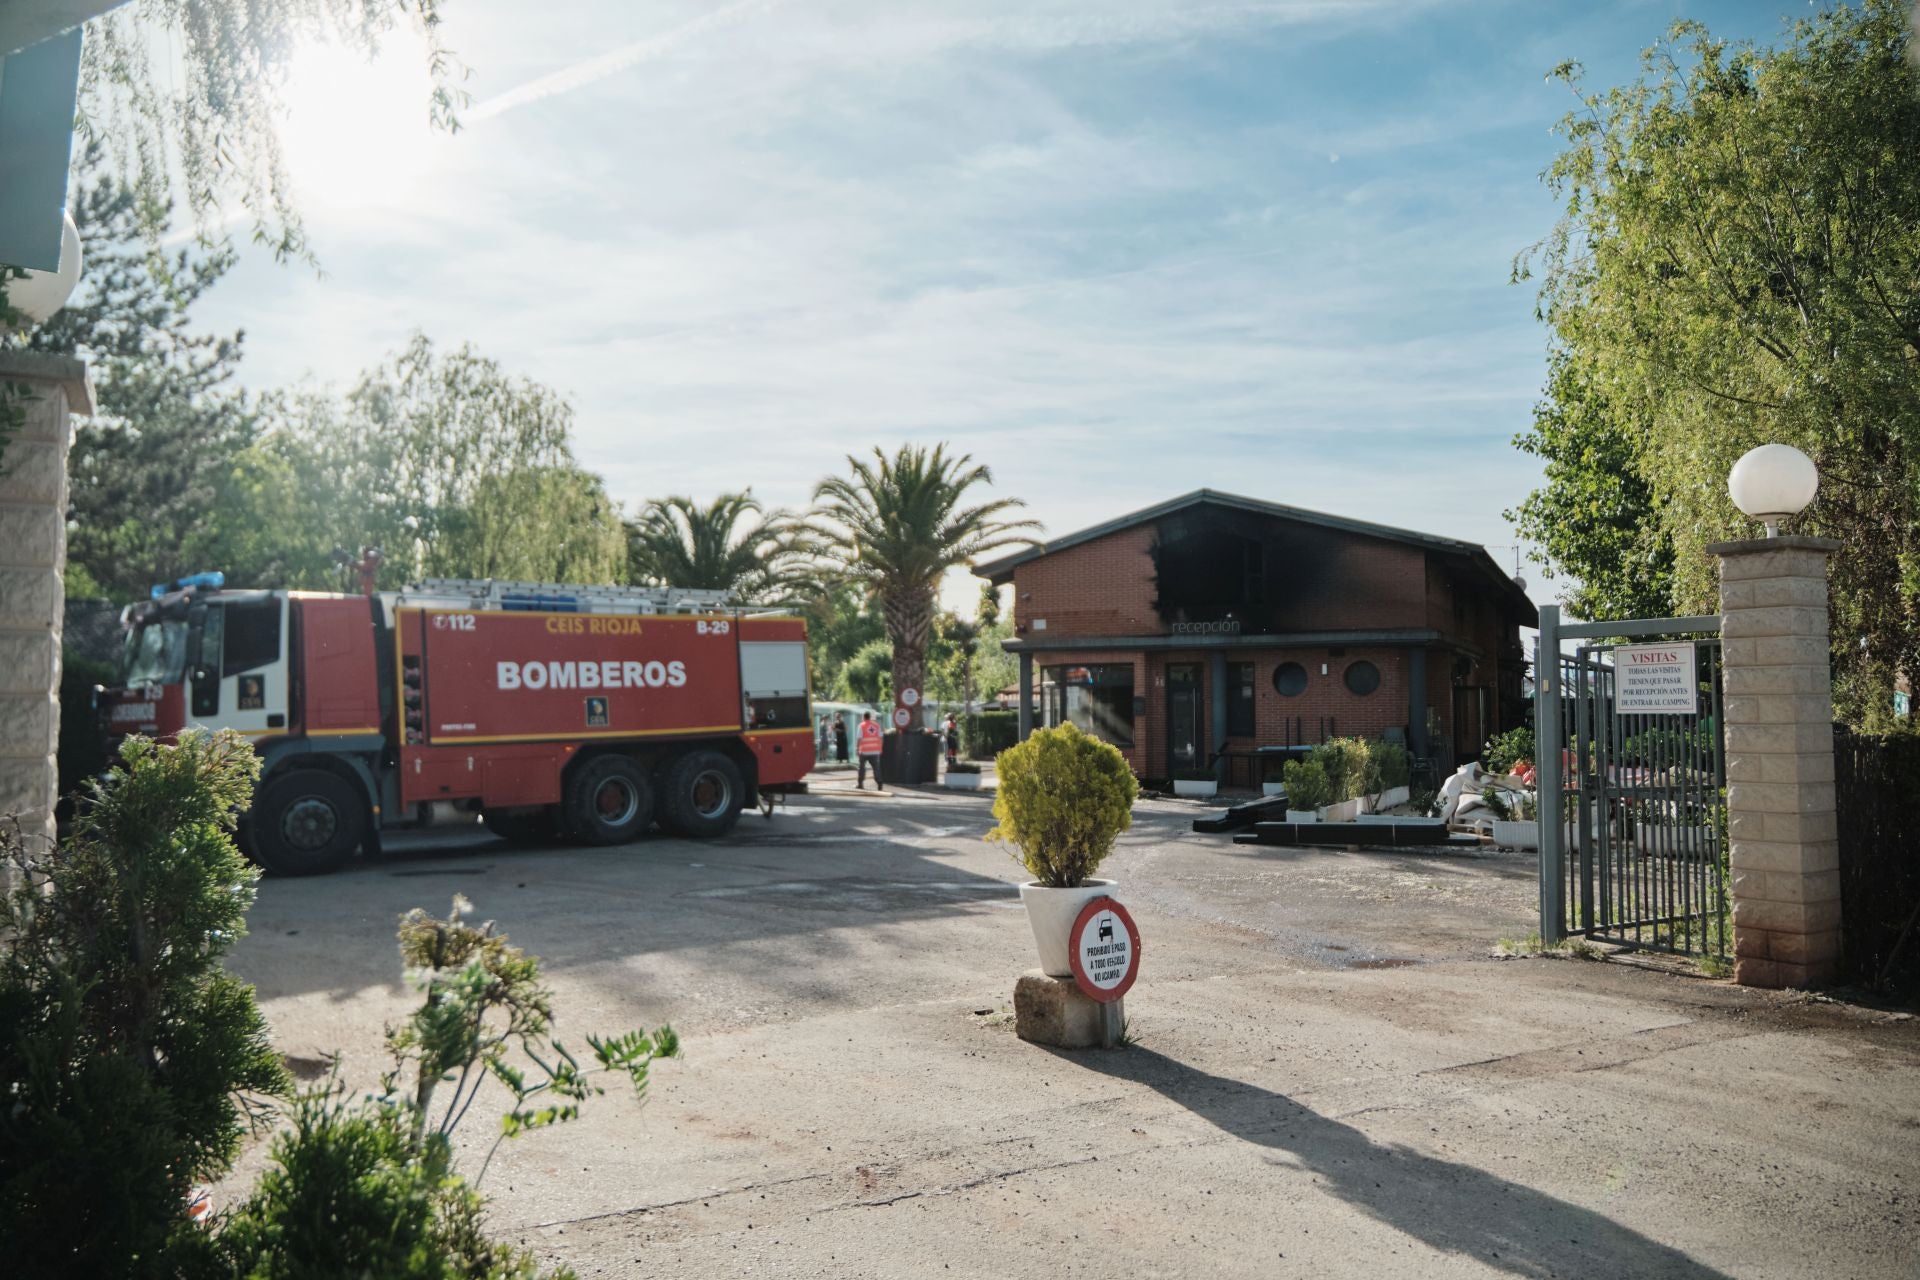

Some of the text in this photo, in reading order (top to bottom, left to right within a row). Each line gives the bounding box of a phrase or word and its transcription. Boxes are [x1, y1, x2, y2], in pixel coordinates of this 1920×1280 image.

[448, 614, 476, 631] 112
[546, 617, 642, 635] CEIS RIOJA
[697, 620, 729, 635] B-29
[1631, 652, 1678, 664] VISITAS
[496, 660, 687, 690] BOMBEROS
[1628, 667, 1646, 675] TODAS
[1659, 666, 1681, 674] VISITAS
[1628, 677, 1682, 686] TIENEN QUE PASAR
[1623, 688, 1635, 696] POR
[1621, 699, 1630, 707] DE
[1630, 699, 1653, 707] ENTRAR
[1662, 698, 1690, 706] CAMPING
